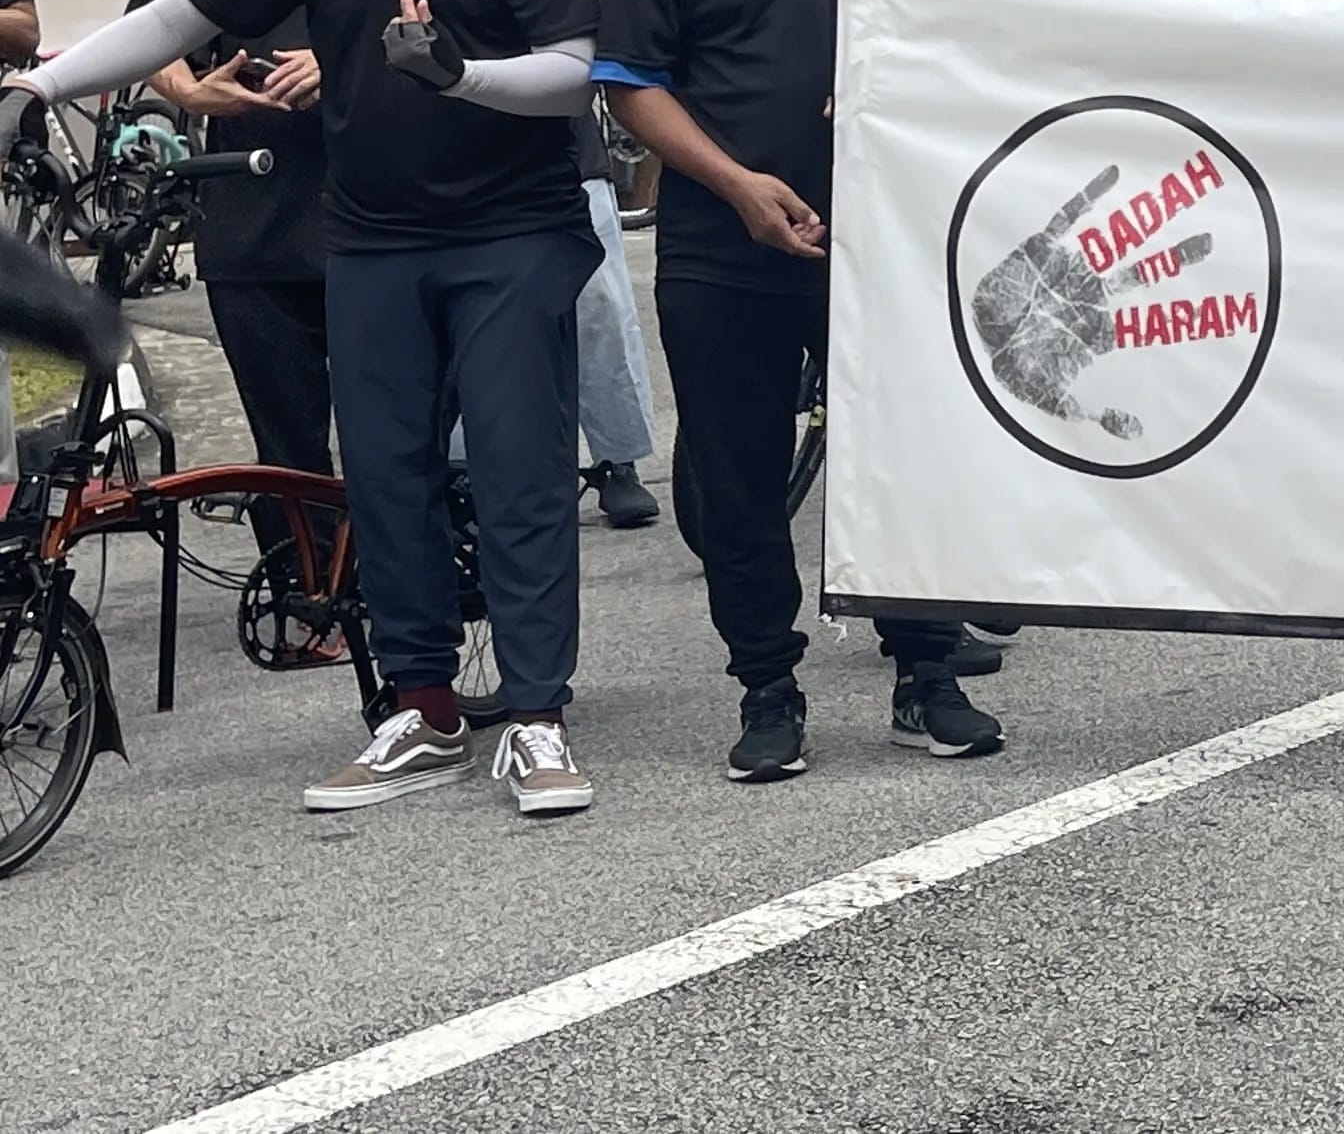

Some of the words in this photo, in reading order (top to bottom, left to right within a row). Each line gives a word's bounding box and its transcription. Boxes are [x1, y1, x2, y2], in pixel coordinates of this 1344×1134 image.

[1077, 149, 1225, 274] DADAH
[1135, 246, 1181, 287] ITU
[1114, 292, 1258, 349] HARAM
